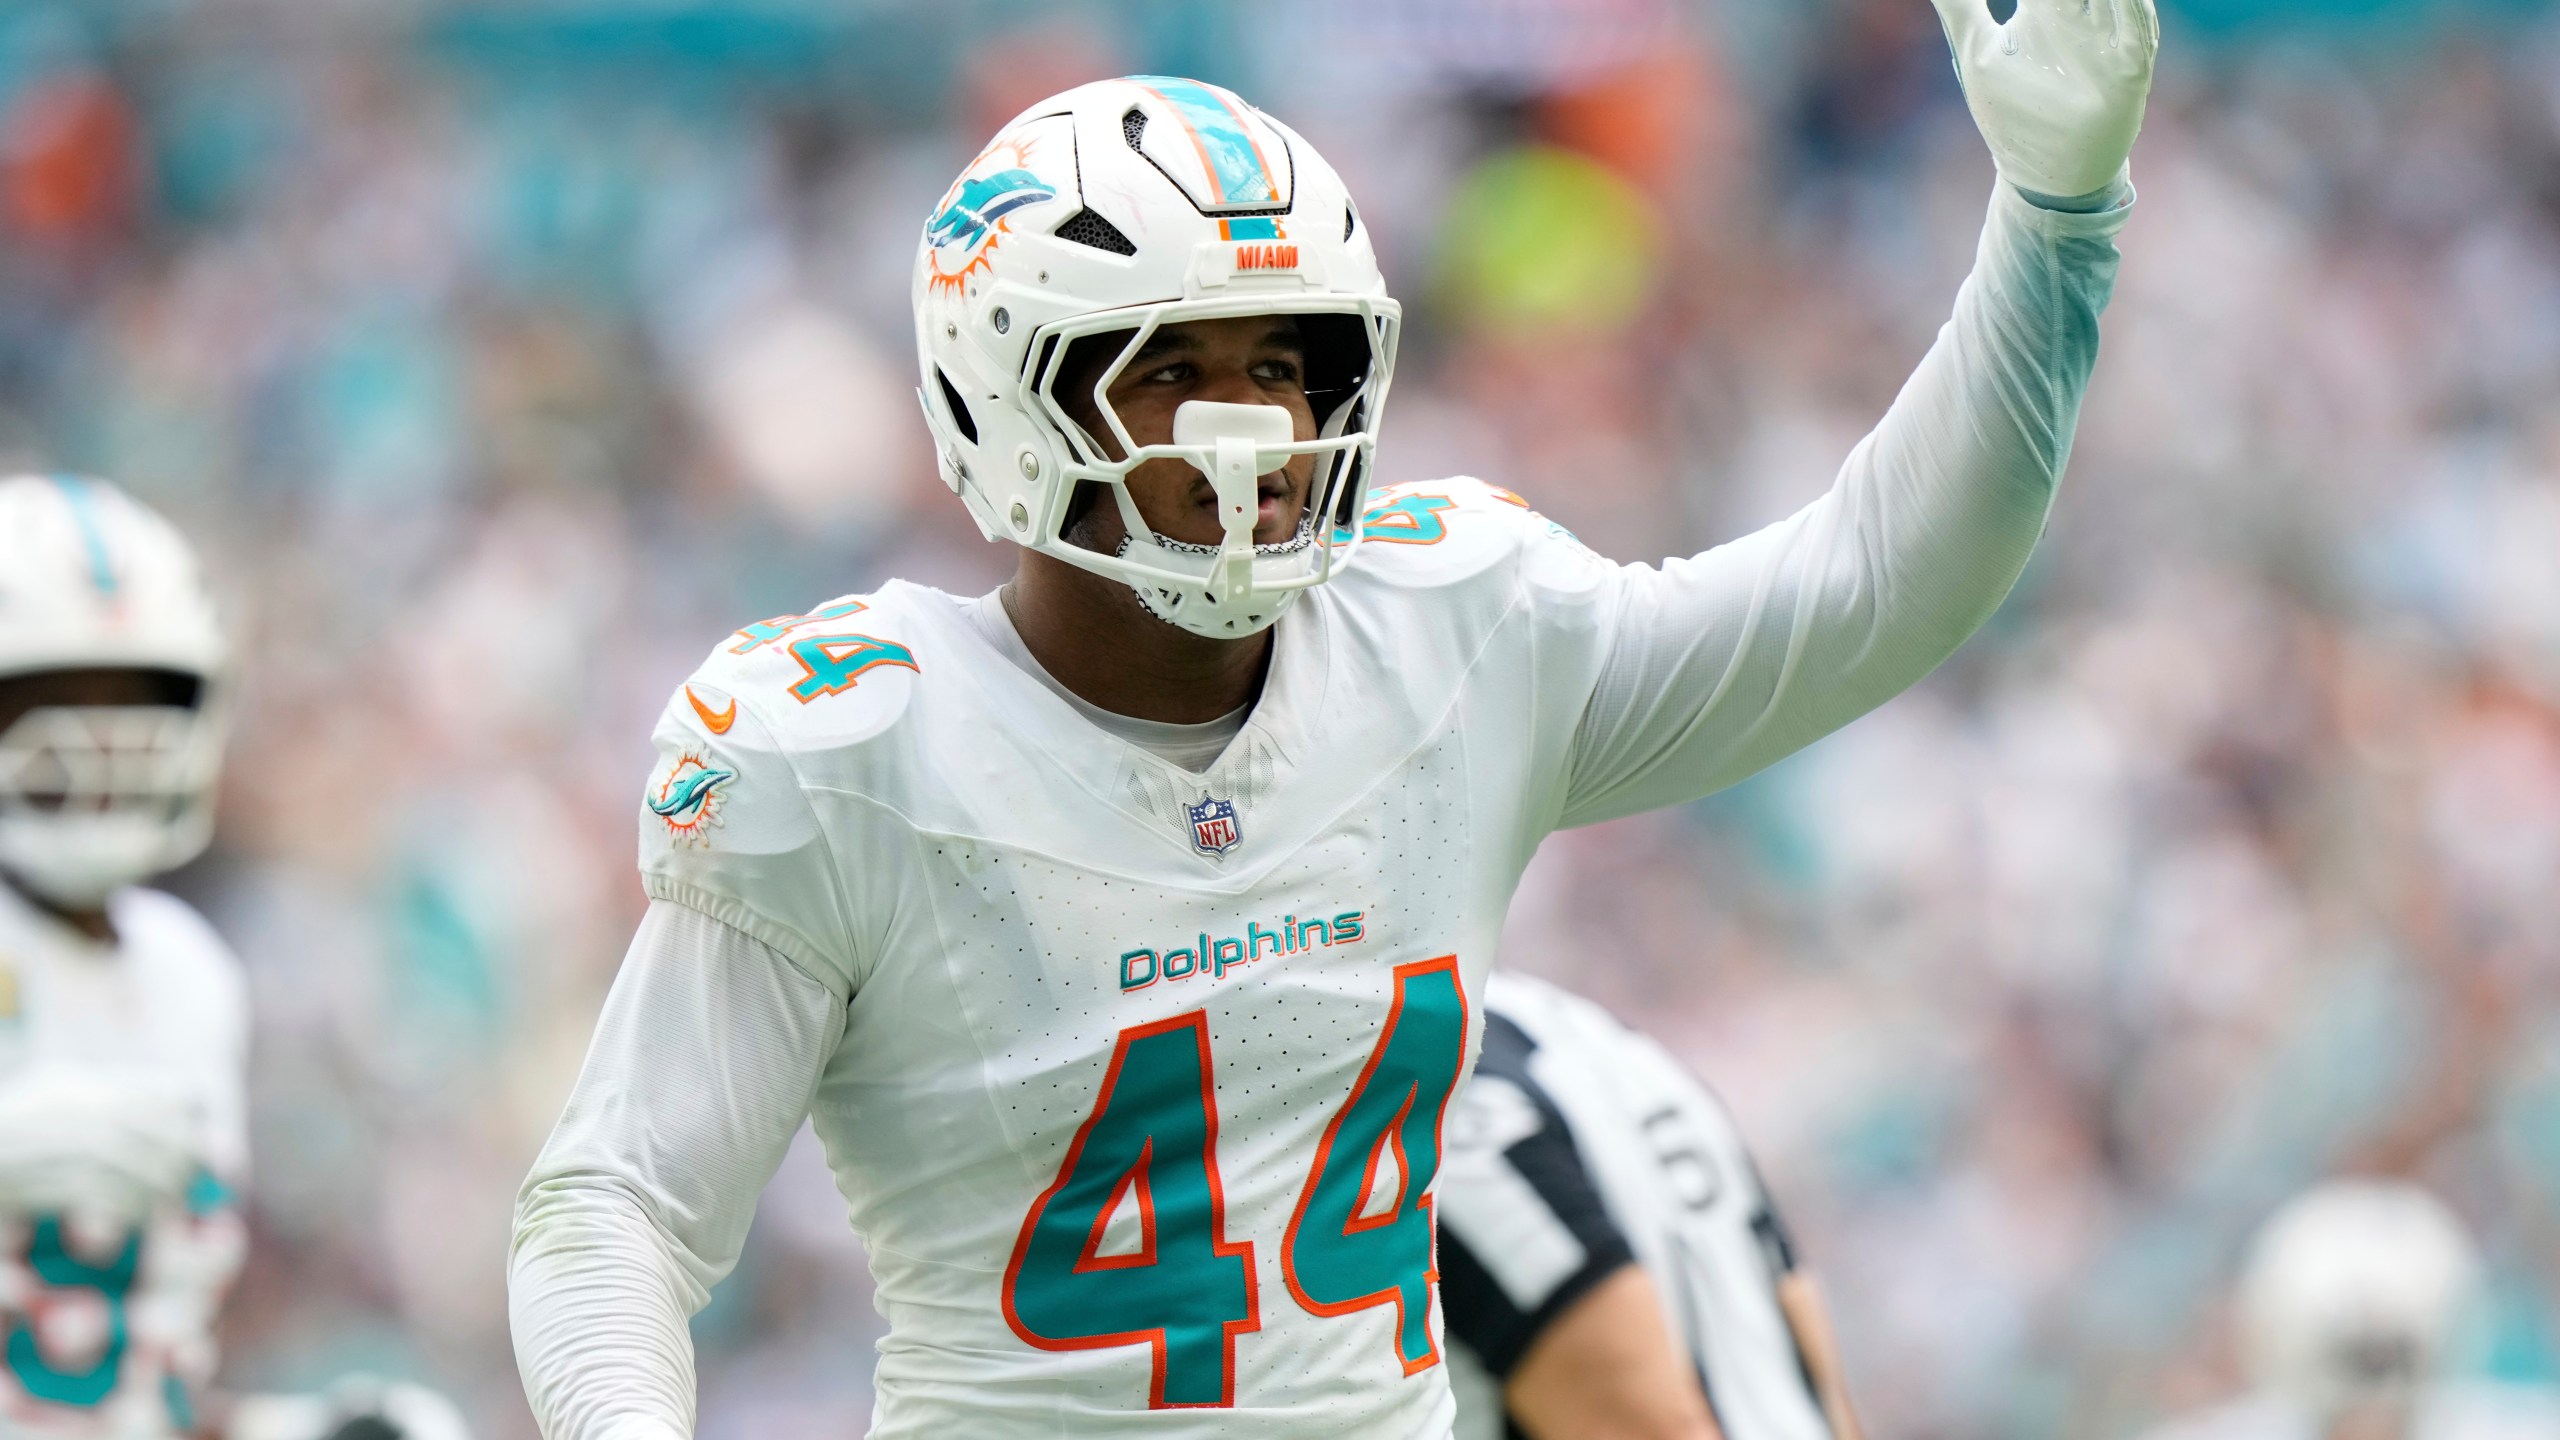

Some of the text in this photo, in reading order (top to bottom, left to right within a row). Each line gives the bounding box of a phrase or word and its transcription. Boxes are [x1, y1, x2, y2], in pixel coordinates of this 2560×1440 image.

[1237, 245, 1298, 271] MIAMI
[727, 600, 921, 704] 44
[1197, 819, 1236, 848] NFL
[1120, 911, 1365, 993] Dolphins
[1000, 953, 1469, 1411] 44
